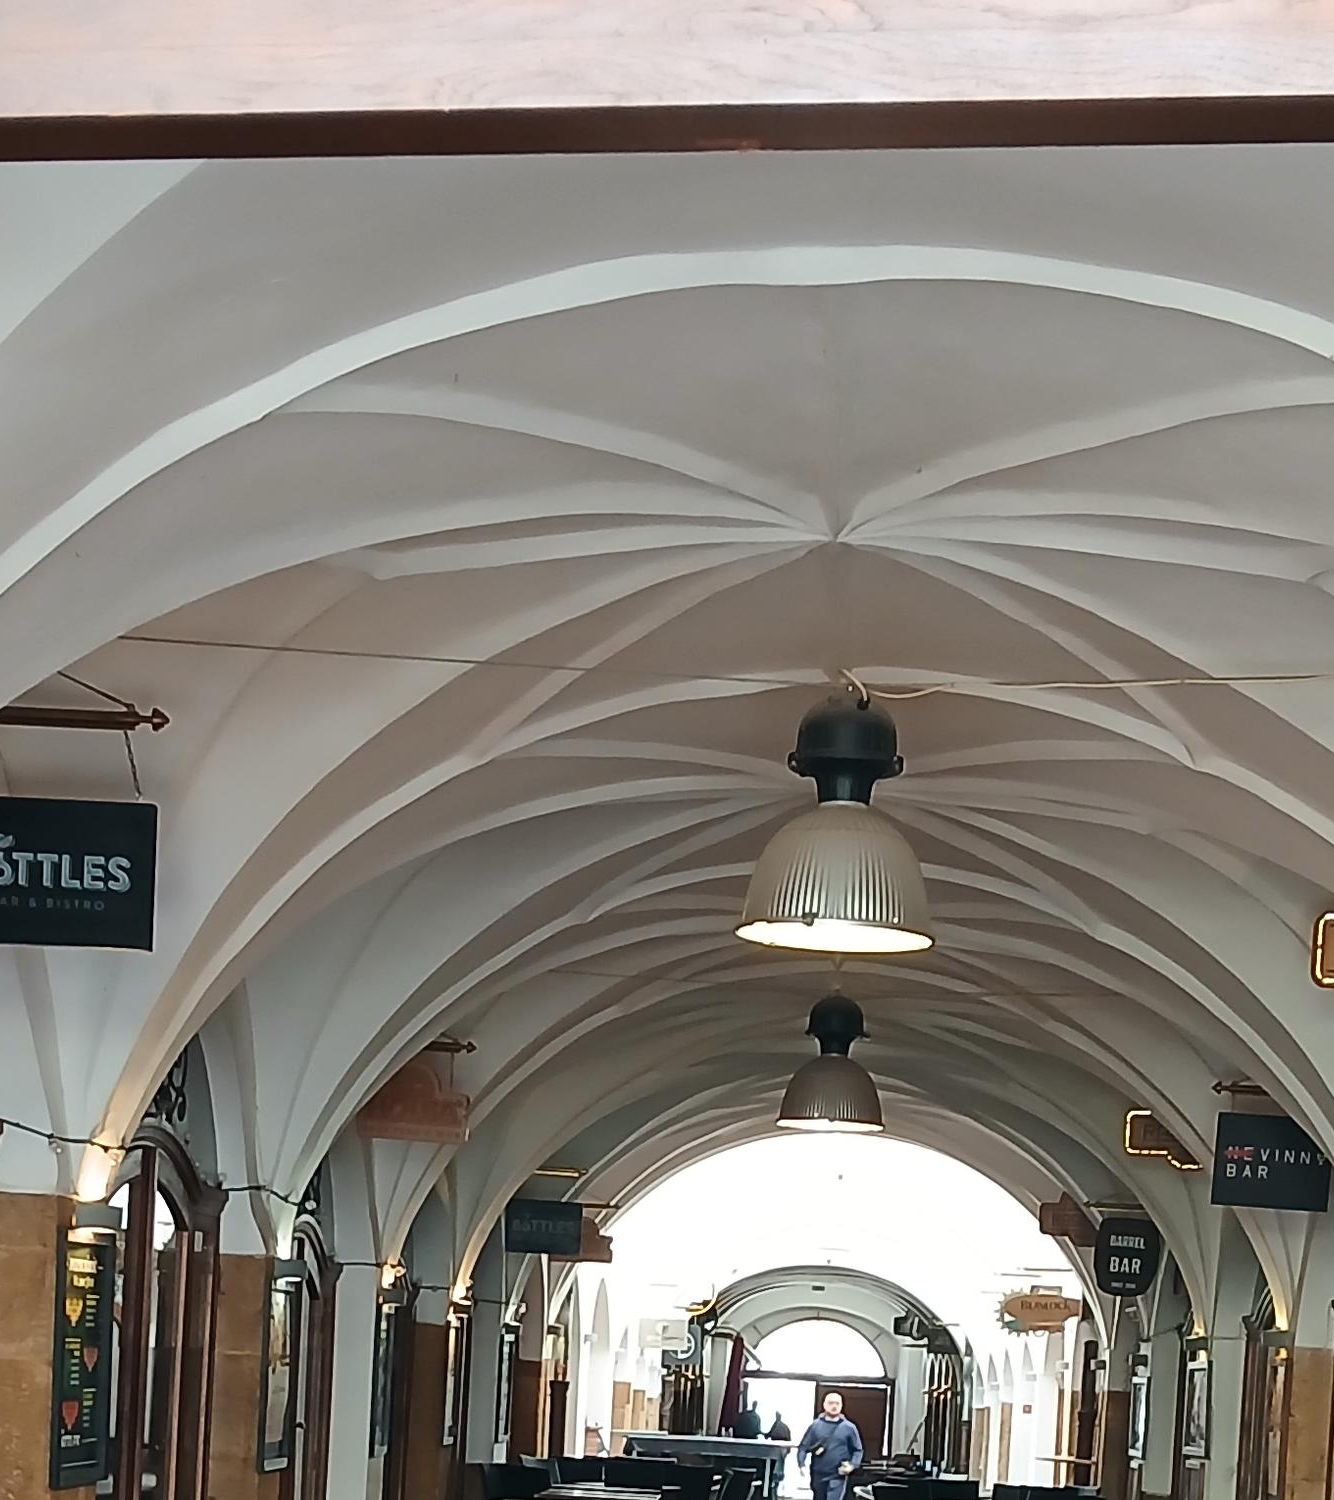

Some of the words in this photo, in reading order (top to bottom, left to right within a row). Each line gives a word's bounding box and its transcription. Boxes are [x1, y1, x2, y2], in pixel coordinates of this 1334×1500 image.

[46, 898, 106, 912] BISTRO
[1226, 1163, 1268, 1179] BAR
[1109, 1234, 1146, 1250] BARREL
[1109, 1256, 1142, 1275] BAR
